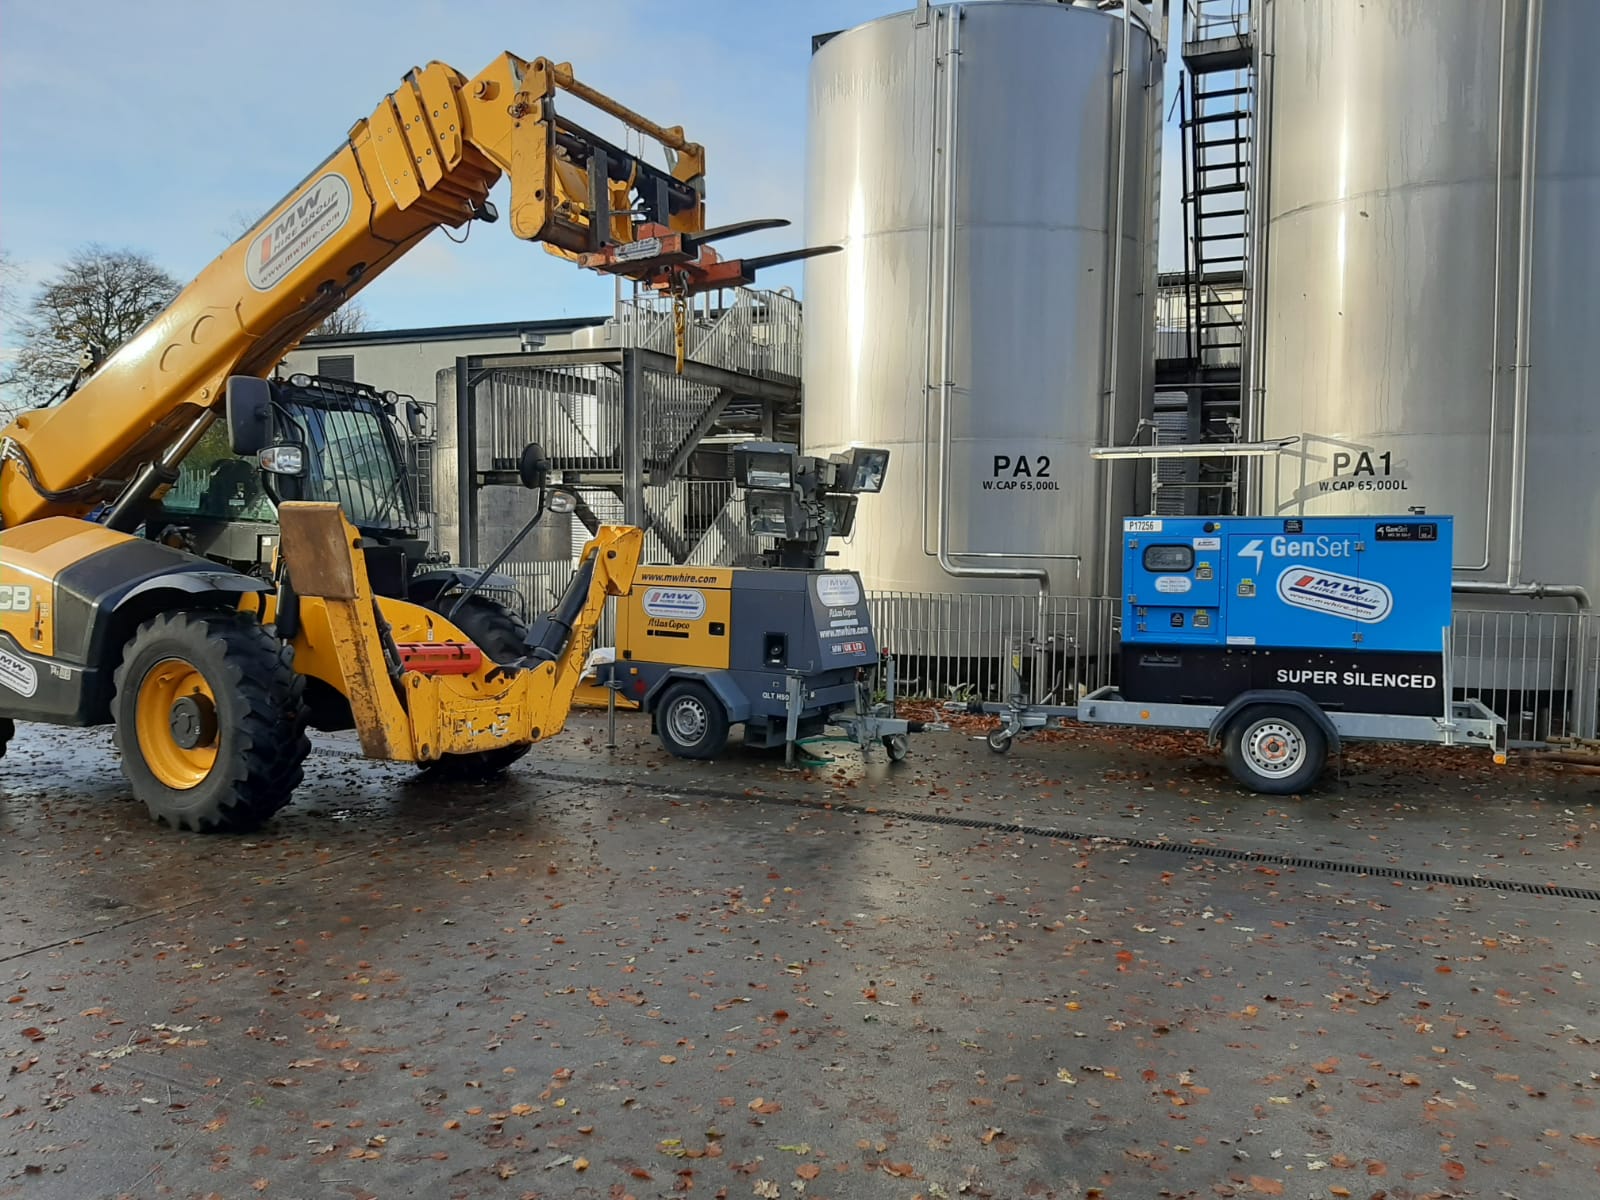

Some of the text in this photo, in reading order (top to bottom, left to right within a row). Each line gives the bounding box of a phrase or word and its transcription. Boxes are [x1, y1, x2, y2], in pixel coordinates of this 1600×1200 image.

[274, 188, 322, 241] MW
[993, 455, 1050, 477] PA2
[1333, 451, 1391, 477] PA1
[982, 480, 1060, 491] W.CAP 65,000L
[1319, 480, 1408, 491] W.CAP 65,000L
[1128, 521, 1154, 531] P17256
[1270, 536, 1350, 558] GenSet
[641, 573, 717, 584] www.mwhire.com
[1316, 578, 1369, 595] MW
[662, 592, 693, 600] MW
[1310, 585, 1380, 605] HIRE GROUP
[648, 618, 690, 630] Atlas Copco
[0, 655, 26, 671] MW
[1276, 669, 1437, 689] SUPER SILENCED
